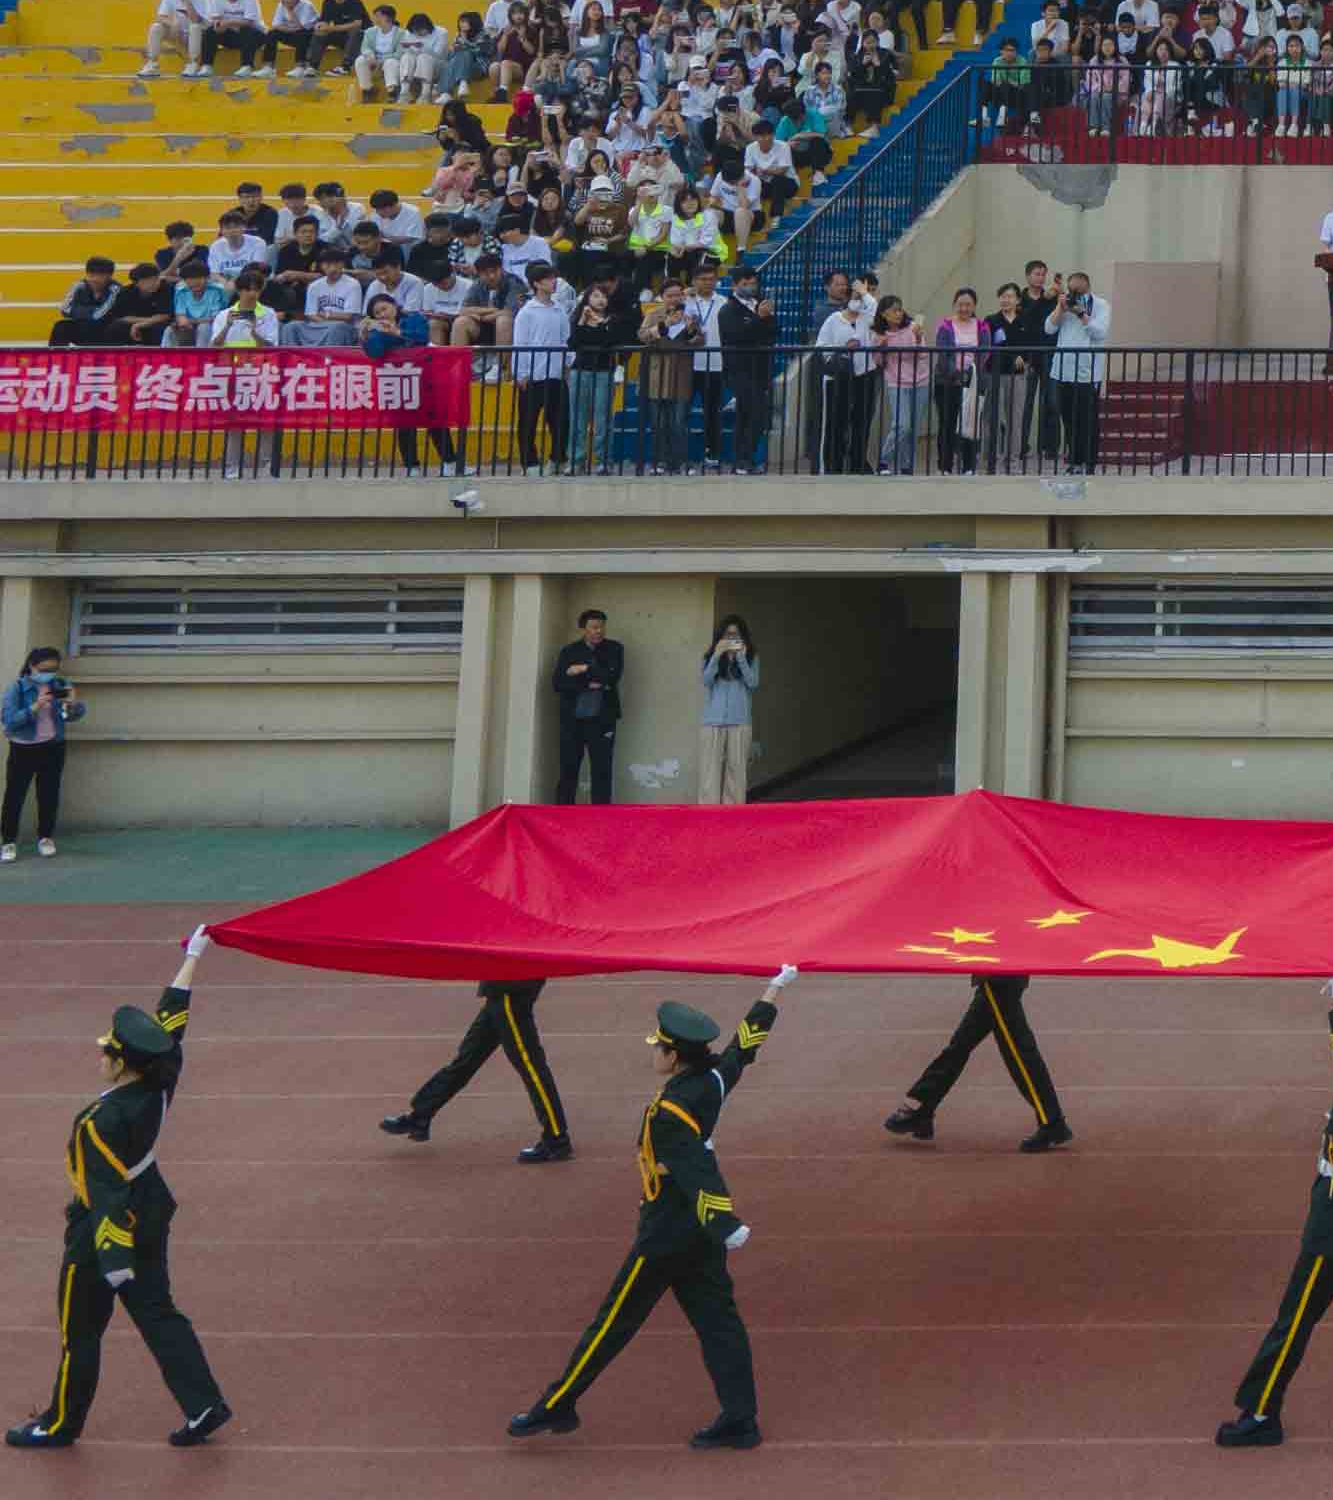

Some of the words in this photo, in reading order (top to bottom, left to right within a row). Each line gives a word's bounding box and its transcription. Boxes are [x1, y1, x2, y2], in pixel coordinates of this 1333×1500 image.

[134, 364, 423, 412] 终点就在眼前
